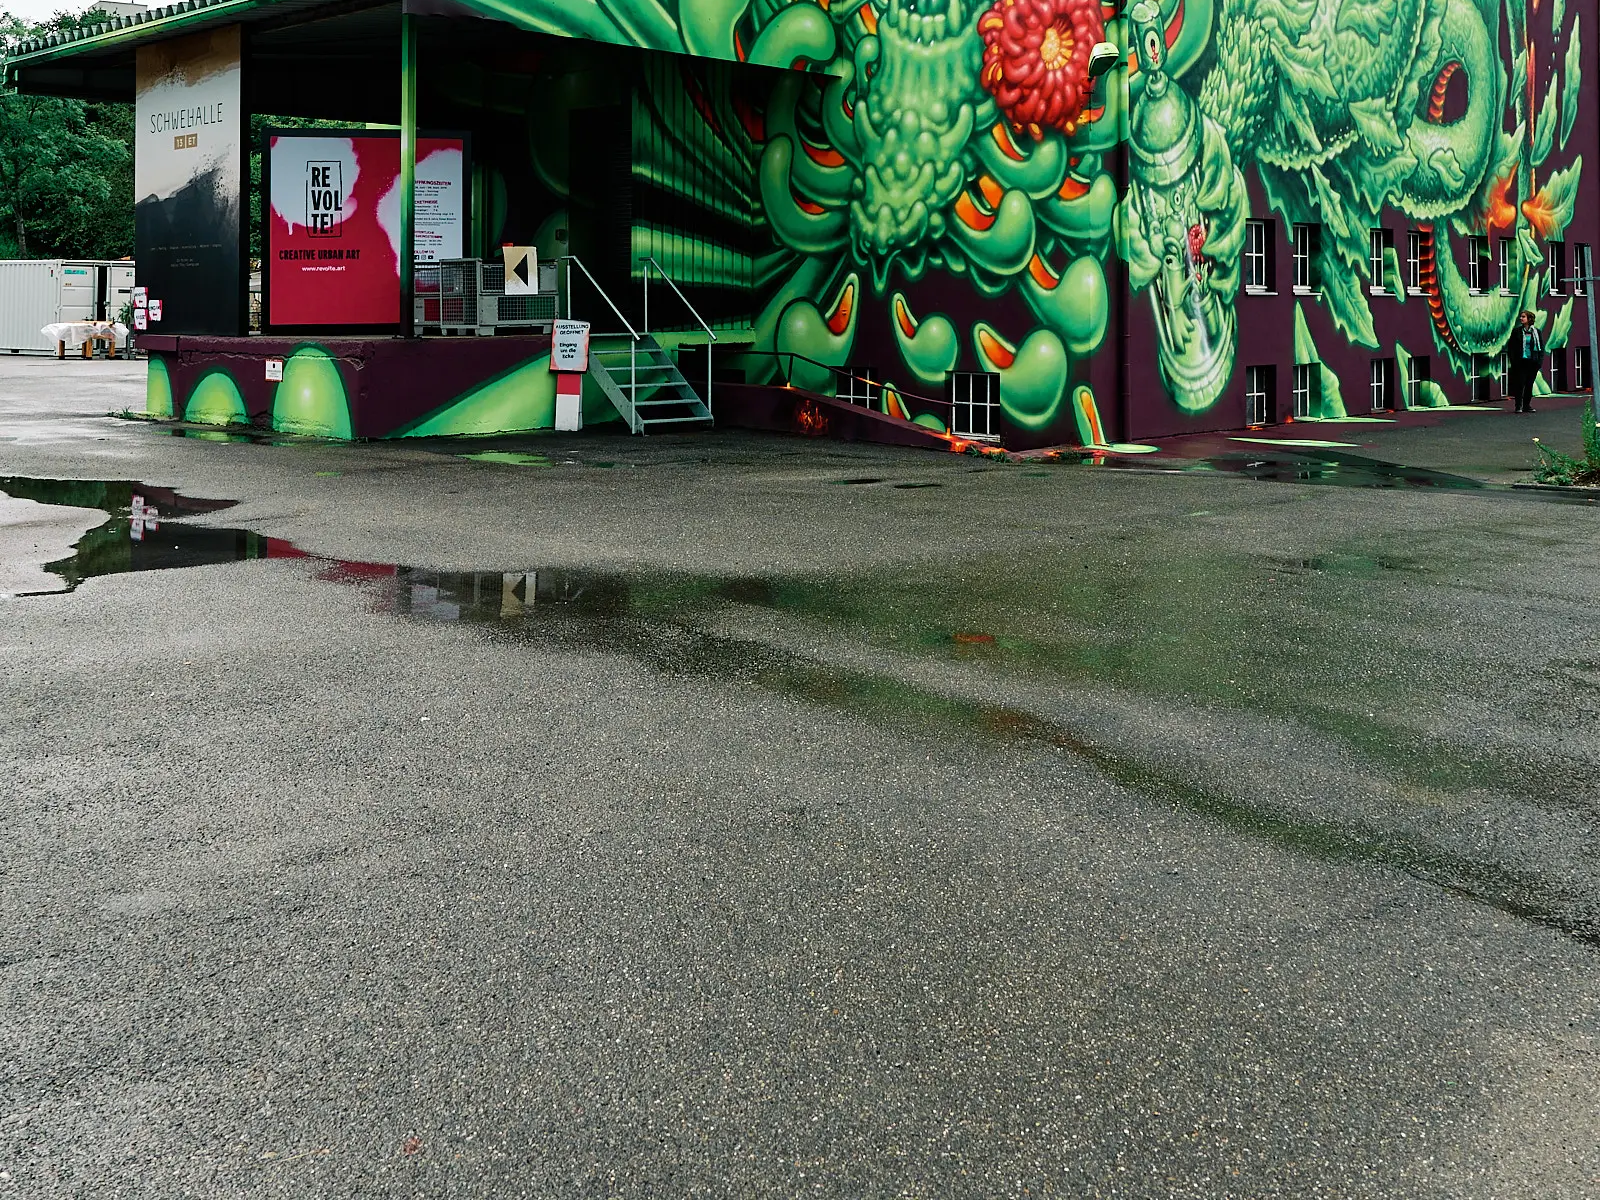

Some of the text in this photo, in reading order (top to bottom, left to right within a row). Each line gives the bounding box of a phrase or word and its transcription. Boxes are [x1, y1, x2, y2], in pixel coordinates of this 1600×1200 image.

[311, 166, 331, 187] RE
[311, 190, 343, 211] VOL
[311, 213, 334, 235] TE!
[279, 249, 361, 261] CREATIVE URBAN ART
